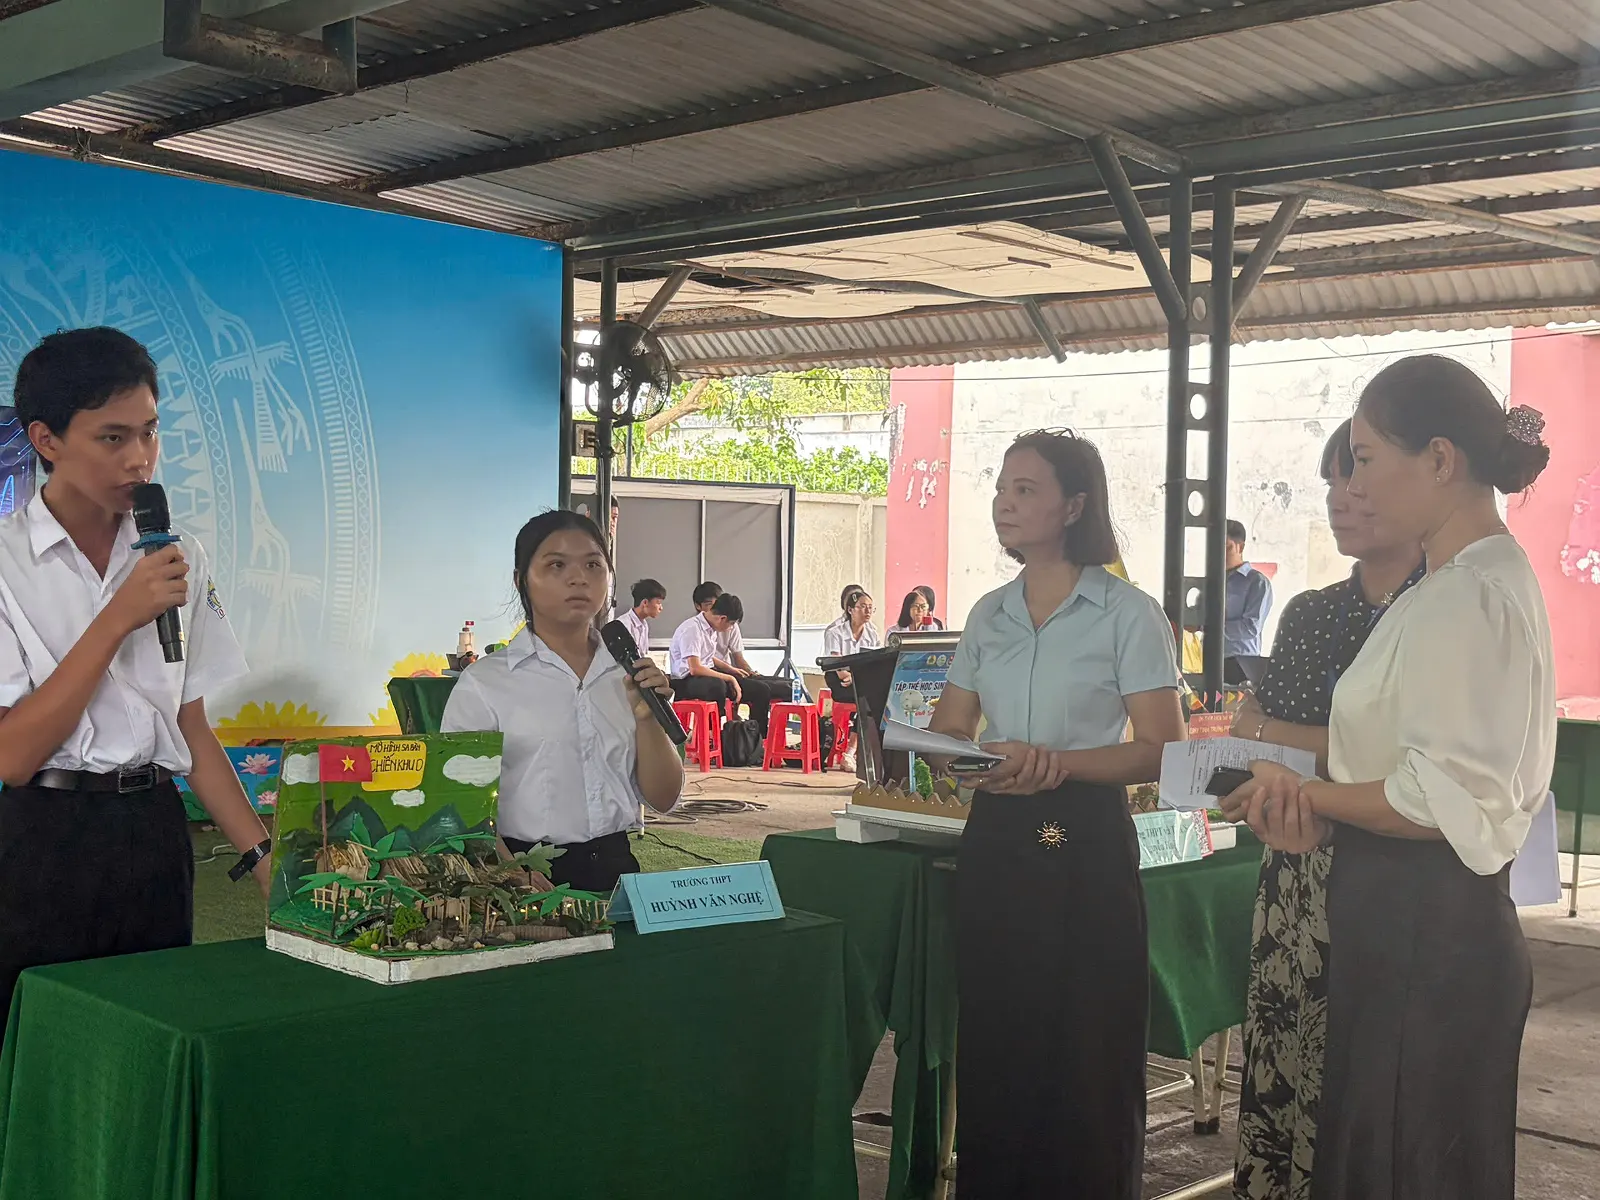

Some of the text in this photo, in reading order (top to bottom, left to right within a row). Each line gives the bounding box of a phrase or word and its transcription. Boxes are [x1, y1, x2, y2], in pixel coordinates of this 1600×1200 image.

[933, 682, 946, 691] SIN
[401, 743, 410, 752] SA
[397, 759, 415, 771] KHU
[670, 874, 732, 889] TRƯỜNG THPT
[650, 891, 765, 913] HUỲNH VĂN NGHỆ
